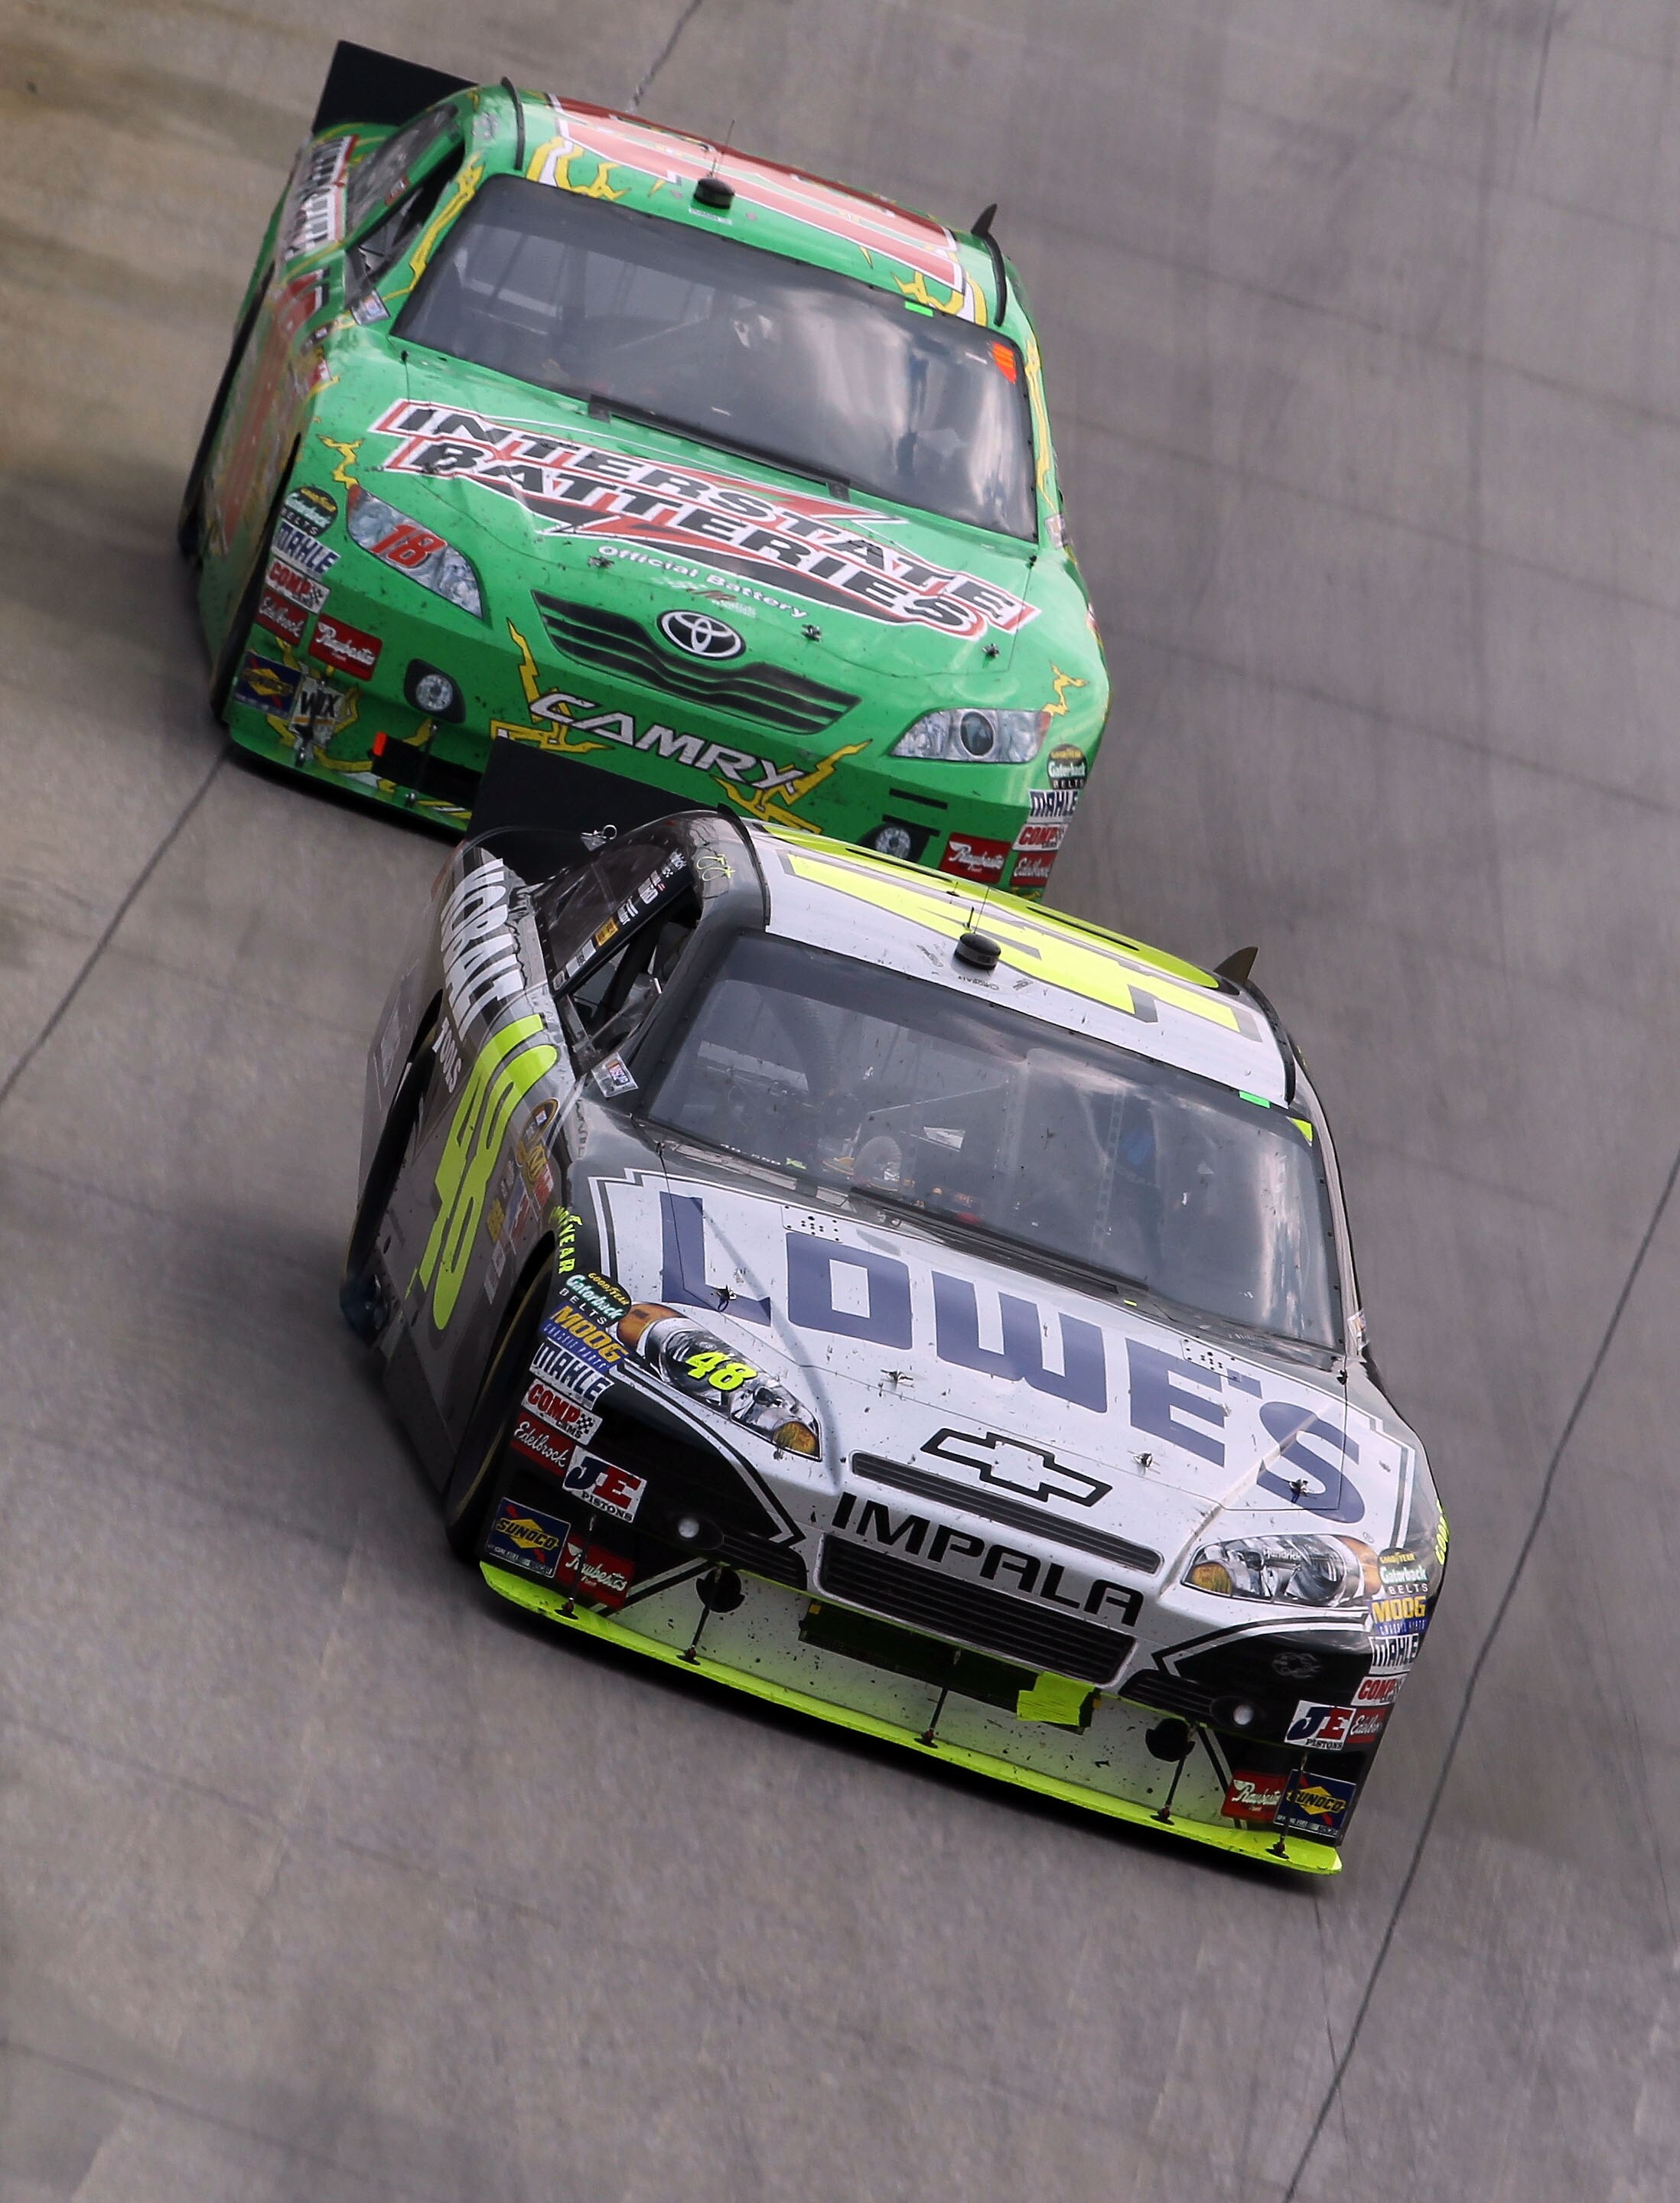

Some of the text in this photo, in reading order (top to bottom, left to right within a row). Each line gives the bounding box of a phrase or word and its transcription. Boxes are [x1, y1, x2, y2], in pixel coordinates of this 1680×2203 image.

[394, 405, 1024, 624] INTERSTATE
[276, 519, 340, 574] MAHLE
[371, 523, 448, 568] 18
[409, 438, 982, 632] BATTERIES
[269, 561, 312, 595] COMP
[598, 545, 699, 578] Official
[705, 574, 809, 620] Battery
[529, 692, 805, 795] CAMRY
[1030, 790, 1079, 818] MAHLE
[1018, 826, 1058, 846] COMP
[439, 857, 524, 1043] KOBALT
[558, 1287, 607, 1326] BELTS
[565, 1274, 627, 1320] Gatorback
[587, 1271, 631, 1306] GOODYEAR
[550, 1304, 630, 1364] MOOG
[532, 1344, 611, 1401] MAHLE
[659, 1190, 1366, 1524] LOWE'S
[685, 1351, 757, 1391] 48
[527, 1382, 581, 1425] COMP
[513, 1420, 570, 1468] Edelbrock
[564, 1456, 643, 1510] JE
[581, 1490, 633, 1524] PISTONS
[497, 1518, 559, 1551] SUNOCO
[832, 1492, 1145, 1627] IMPALA
[1380, 1565, 1428, 1584] Gatorback
[1371, 1596, 1426, 1622] MOOG
[1388, 1583, 1428, 1595] BELTS
[1369, 1635, 1418, 1667] MAHLE
[1358, 1677, 1396, 1700] COMP
[1287, 1706, 1354, 1740] JE
[1305, 1738, 1343, 1749] PISTONS
[1287, 1790, 1346, 1814] UNOCO
